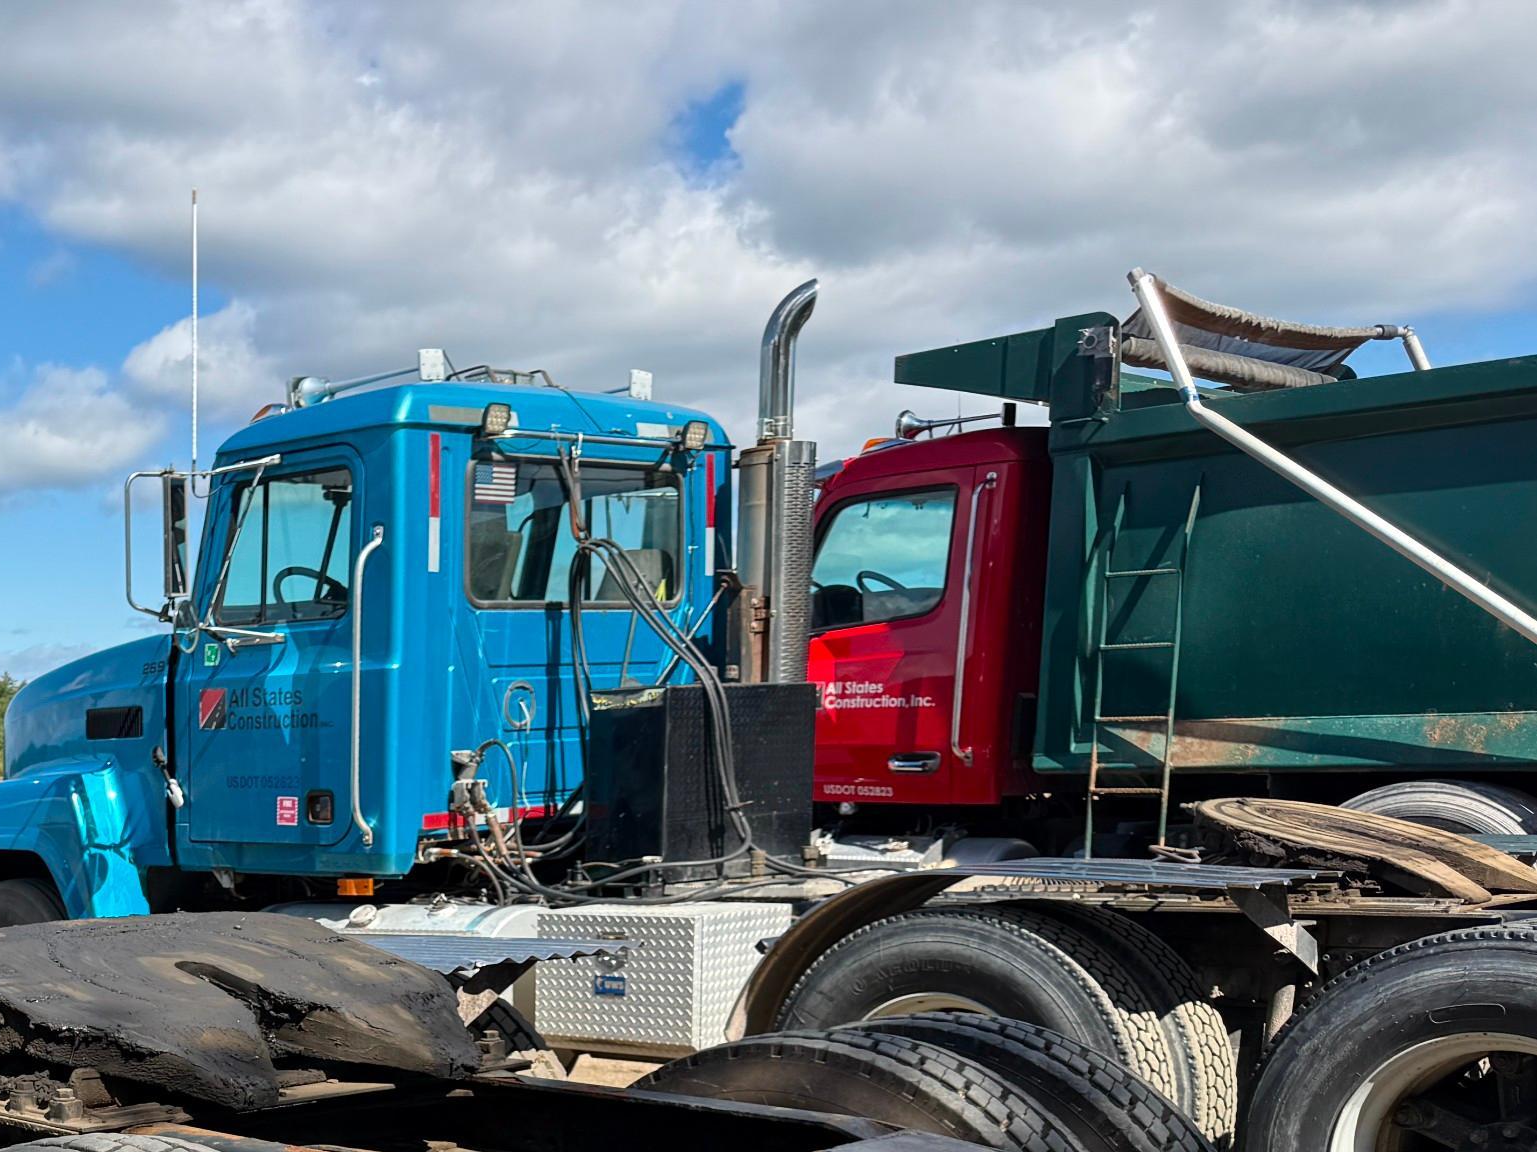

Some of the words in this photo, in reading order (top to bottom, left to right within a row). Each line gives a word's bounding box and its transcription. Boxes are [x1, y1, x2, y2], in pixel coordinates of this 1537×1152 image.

[825, 681, 843, 695] All
[844, 681, 884, 694] States
[228, 688, 249, 708] All
[253, 687, 303, 708] States
[910, 694, 936, 707] Inc.
[227, 710, 319, 731] Construction
[823, 784, 856, 795] USDOT
